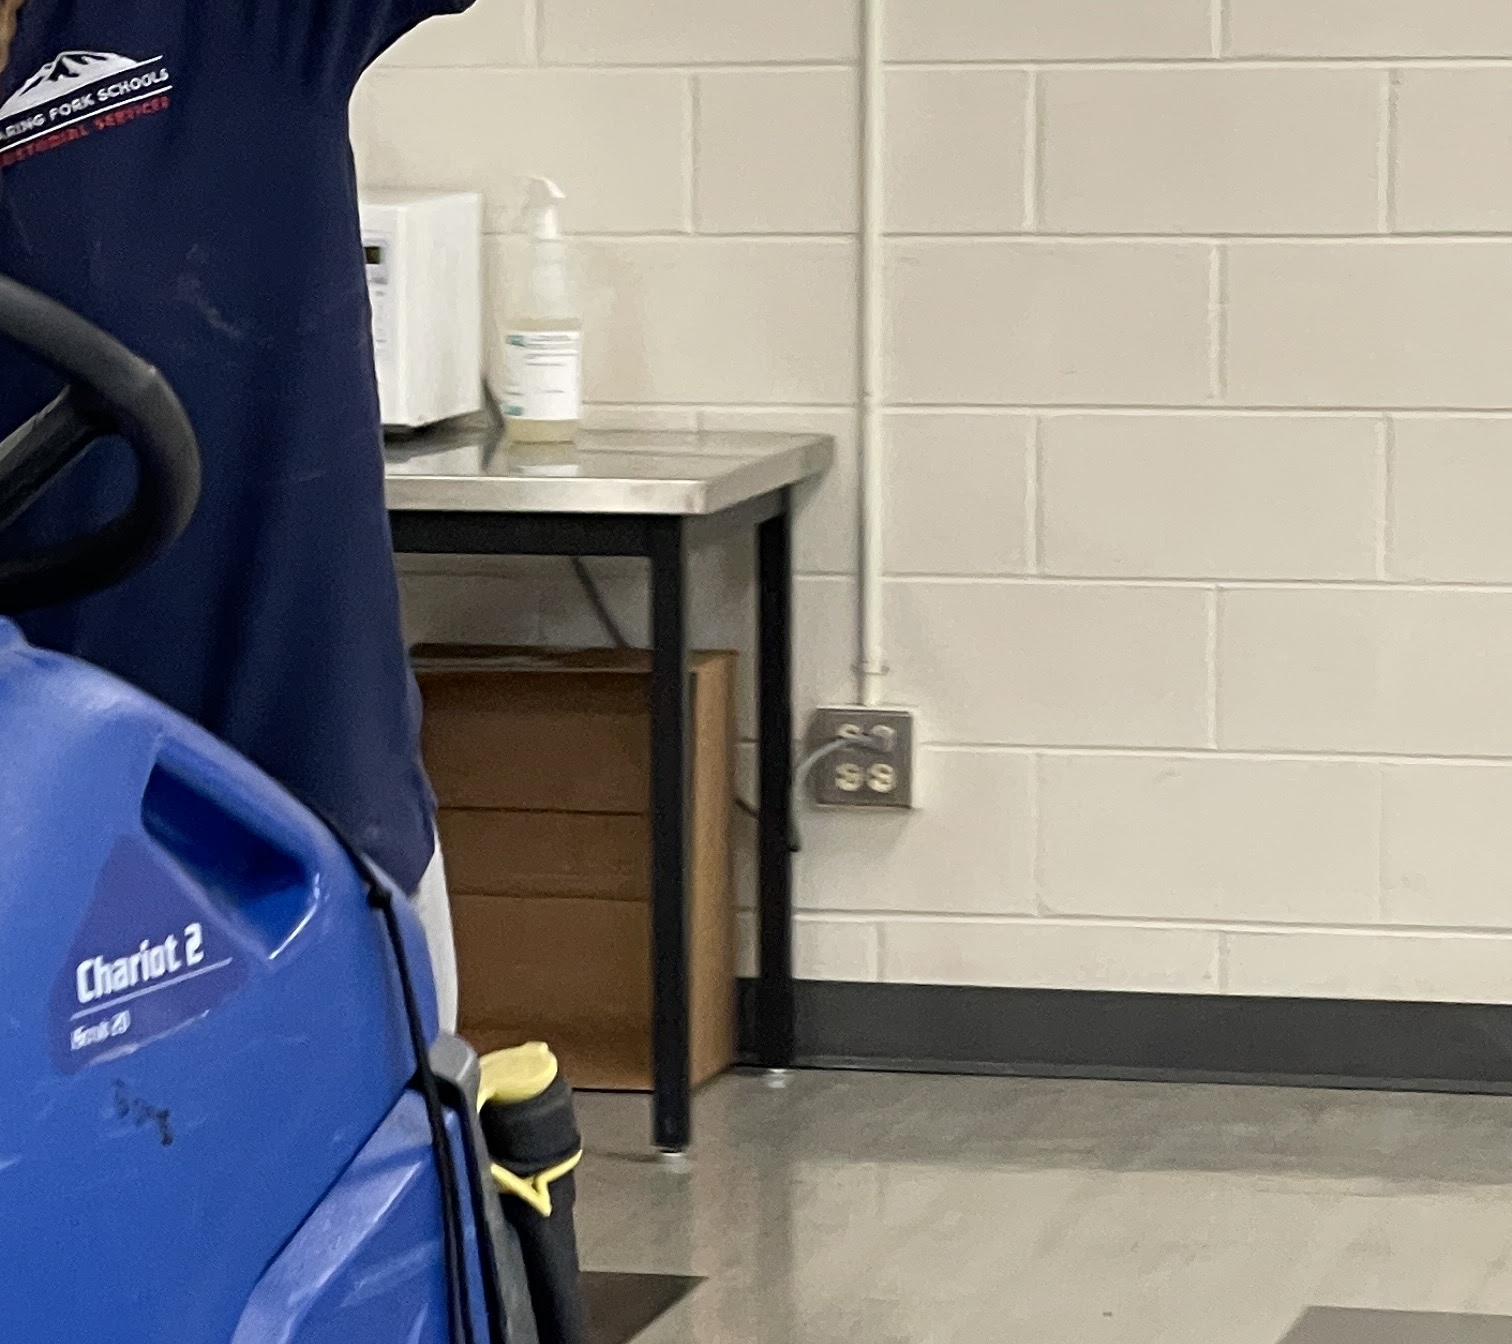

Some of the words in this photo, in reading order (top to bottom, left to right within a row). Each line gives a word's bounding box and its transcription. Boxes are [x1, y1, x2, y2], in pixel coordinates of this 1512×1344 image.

[49, 93, 96, 122] FORK
[96, 67, 170, 102] SCHOOLS
[76, 934, 182, 1003] Chariot
[184, 922, 205, 967] 2
